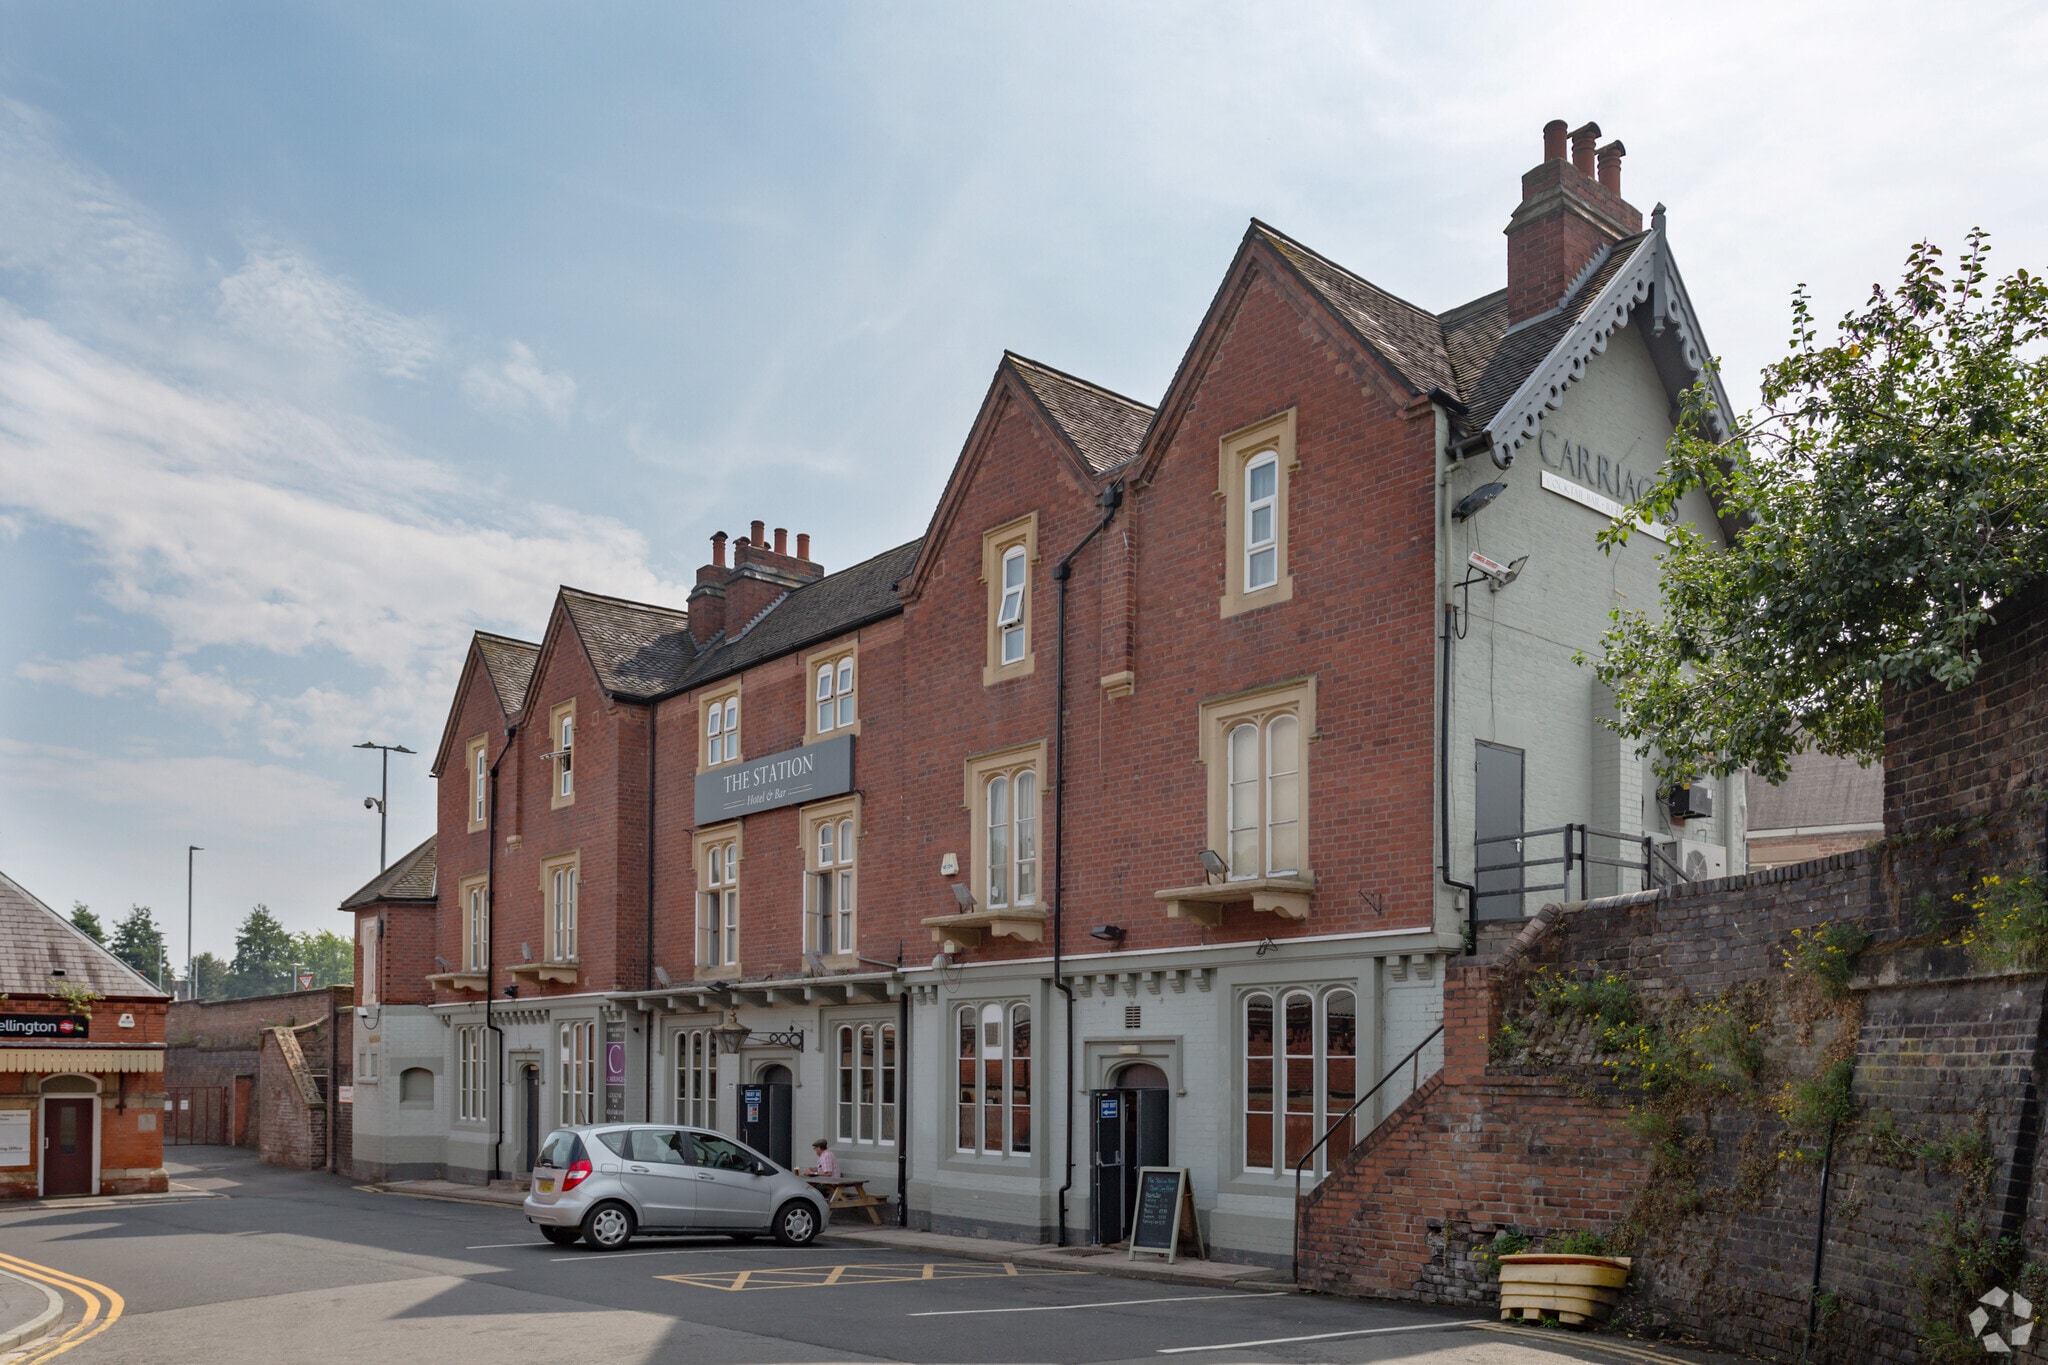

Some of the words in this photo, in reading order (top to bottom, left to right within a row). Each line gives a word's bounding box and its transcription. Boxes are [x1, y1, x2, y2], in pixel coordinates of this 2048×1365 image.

[1546, 477, 1584, 501] COCKTAIL
[723, 771, 750, 793] THE
[753, 753, 813, 786] STATION
[747, 790, 765, 806] Hotel
[766, 789, 774, 801] &
[774, 788, 787, 799] Bar
[0, 1019, 57, 1035] ellington
[608, 1044, 622, 1074] C
